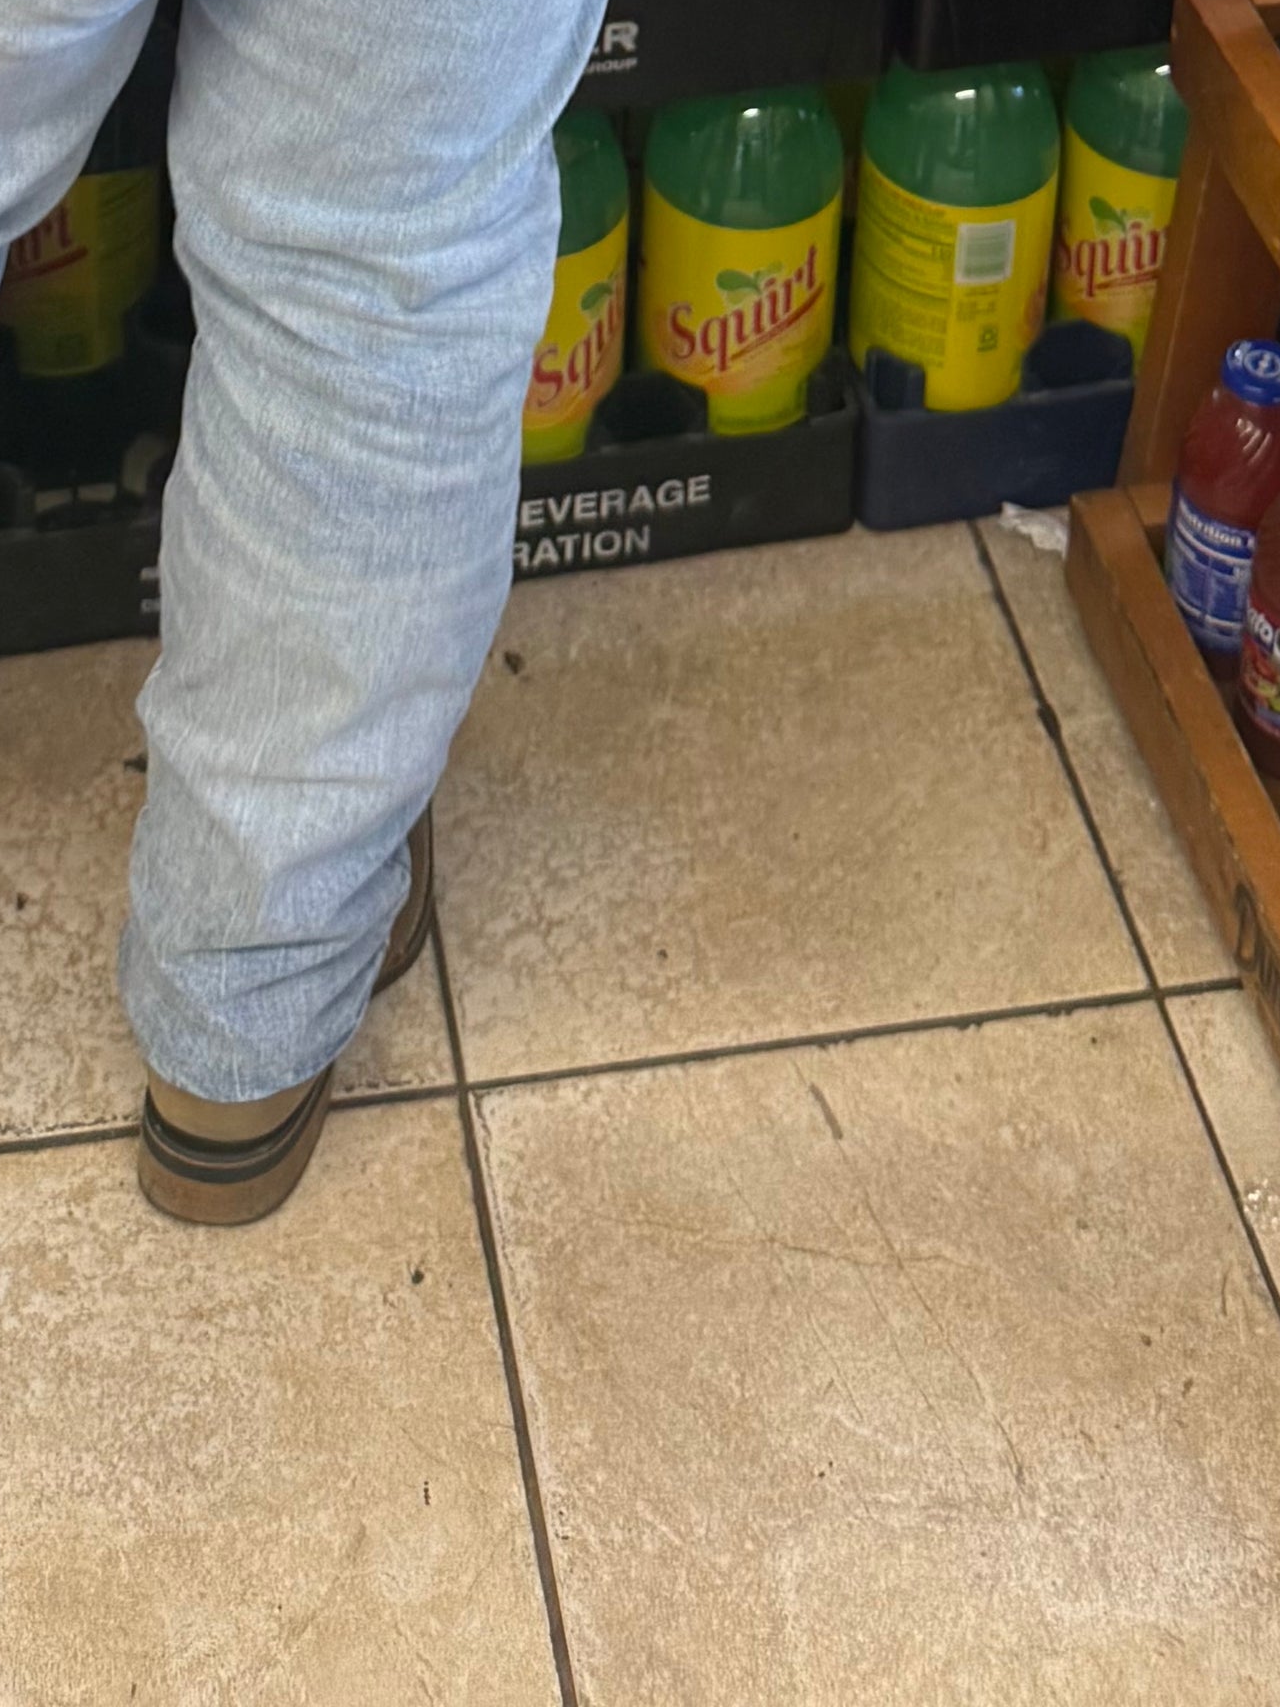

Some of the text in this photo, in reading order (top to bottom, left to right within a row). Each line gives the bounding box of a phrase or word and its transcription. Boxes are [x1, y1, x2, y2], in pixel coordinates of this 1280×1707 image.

[668, 244, 827, 372] Squirt
[520, 475, 713, 532] EVERAGE
[513, 527, 652, 569] RATION
